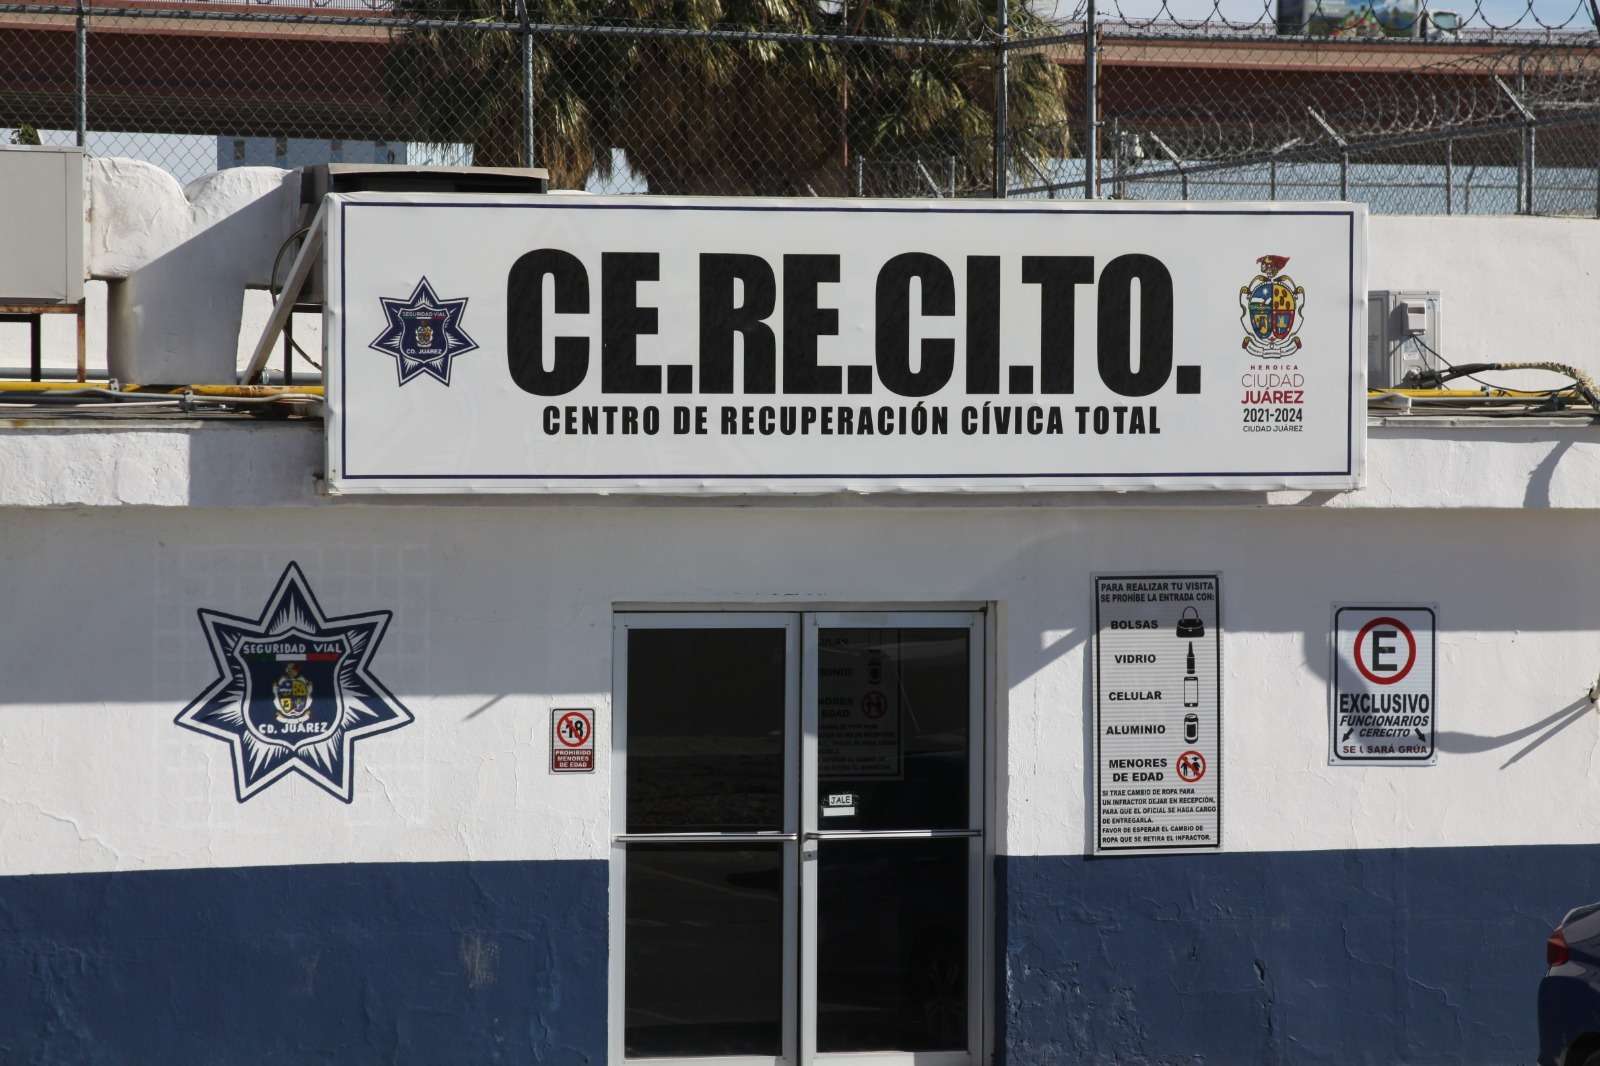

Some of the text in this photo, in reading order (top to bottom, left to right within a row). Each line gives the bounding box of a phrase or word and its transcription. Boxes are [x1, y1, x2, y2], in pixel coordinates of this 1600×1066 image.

[507, 248, 1202, 397] CE.RE.CI.TO.
[1241, 373, 1304, 388] CIUDAD
[1241, 386, 1304, 404] JUÁREZ
[542, 401, 1161, 435] CENTRO DE RECUPERACIÓN CÍVICA TOTAL
[1243, 408, 1302, 422] 2021-2024
[1101, 584, 1123, 592] PARA
[1127, 583, 1168, 591] REALIZAR
[1185, 582, 1213, 590] VISITA
[1101, 594, 1110, 602] SE
[1160, 593, 1194, 601] ENTRADA
[1196, 593, 1214, 601] CON:
[1111, 621, 1158, 629] BOLSAS
[243, 644, 342, 654] SEGURIDAD VIAL
[1372, 631, 1397, 671] E
[1115, 654, 1156, 663] VIDRIO
[1109, 691, 1161, 700] CELULAR
[1339, 693, 1429, 713] EXCLUSIVO
[1340, 715, 1429, 727] FUNCIONARIOS
[258, 724, 277, 734] CD.
[1106, 725, 1165, 735] ALUMINIO
[1359, 728, 1410, 737] CERECITO
[1343, 745, 1356, 753] SE
[1396, 743, 1427, 753] GRÚA
[1109, 759, 1167, 768] MENORES
[1113, 772, 1163, 782] DE EDAD
[831, 795, 850, 804] JALE
